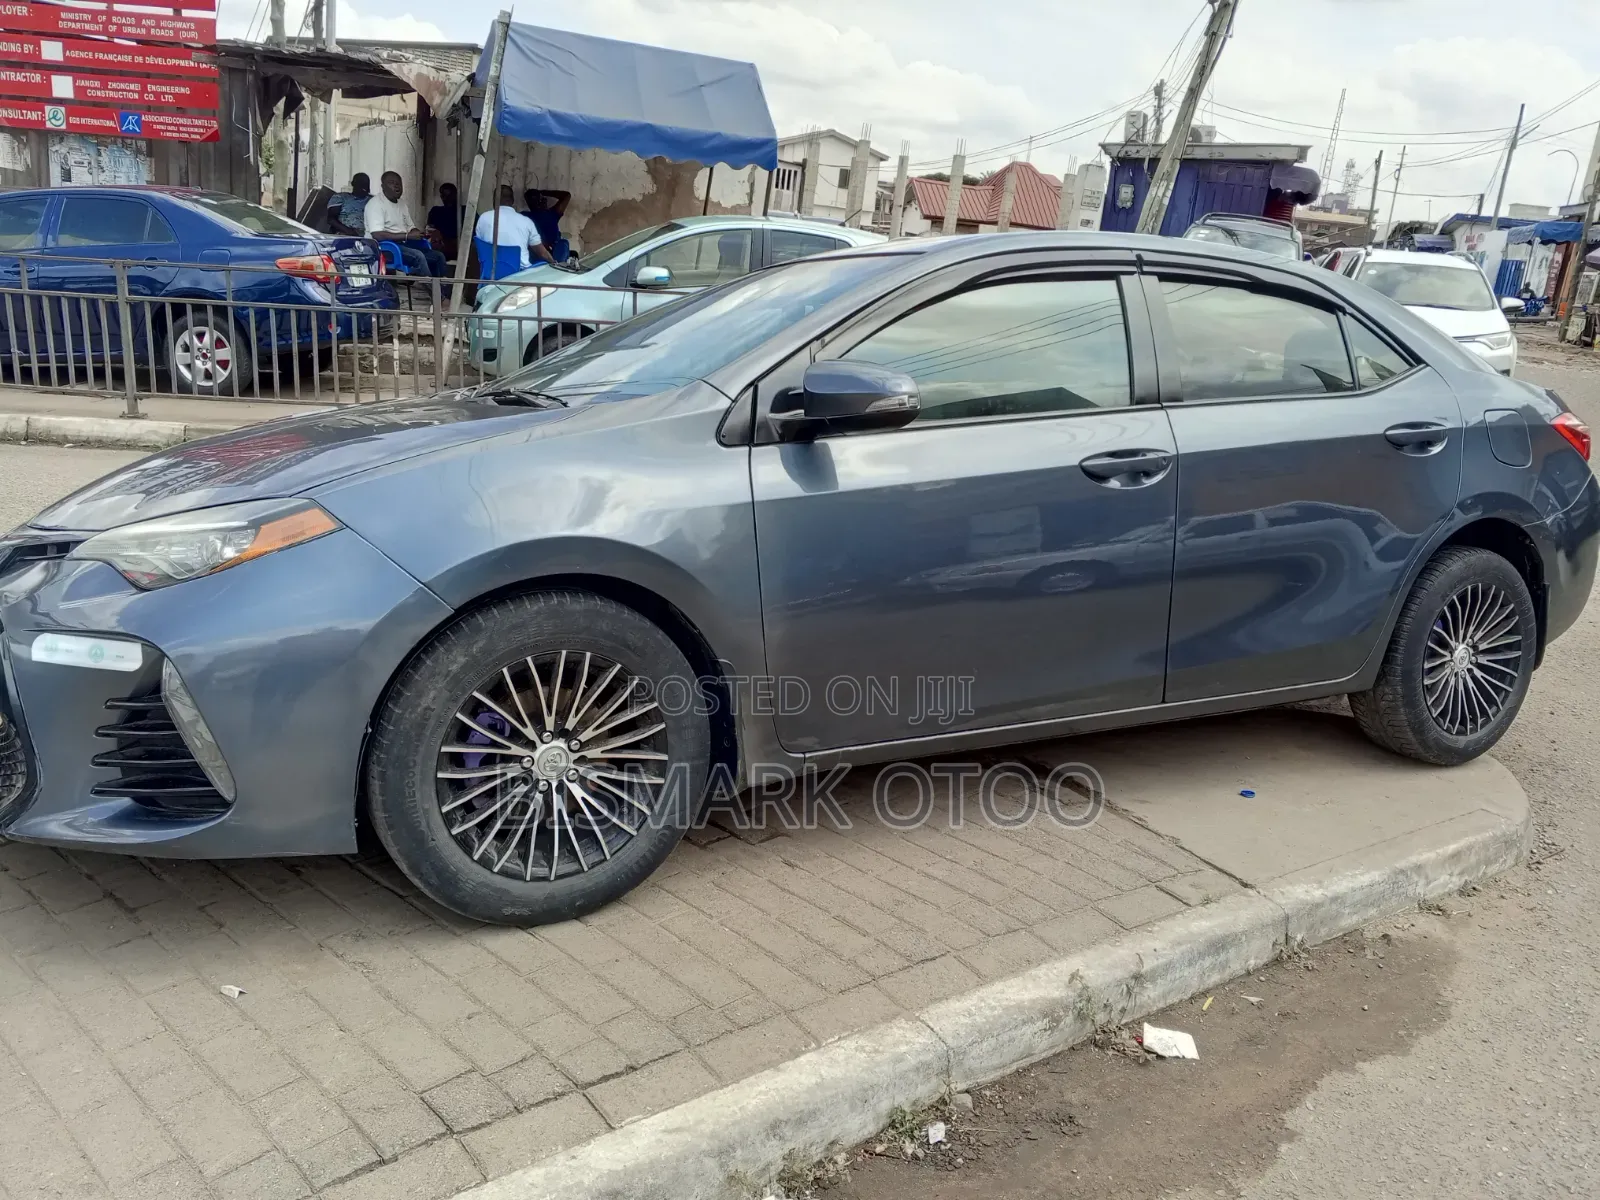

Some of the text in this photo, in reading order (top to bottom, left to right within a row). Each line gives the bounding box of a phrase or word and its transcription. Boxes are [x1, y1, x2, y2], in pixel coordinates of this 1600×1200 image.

[0, 4, 28, 16] LOYER
[60, 12, 92, 21] MINISTRY
[97, 15, 107, 23] OF
[111, 16, 136, 25] ROADS
[160, 20, 195, 29] HIGHWAYS
[58, 20, 199, 39] DEPARTMENT OF URBAN ROADS (DUR)
[23, 43, 34, 54] BY
[65, 50, 94, 59] AGENCE
[94, 52, 133, 63] FRANÇAISE
[134, 56, 144, 64] DE
[107, 81, 141, 91] ZHONGMEI
[147, 84, 191, 95] ENGINEERING
[86, 89, 176, 103] CONSTRUCTION CO. LTD.
[69, 116, 117, 128] EGIS INTERNATIONAL
[141, 114, 172, 124] ASSOCIATED
